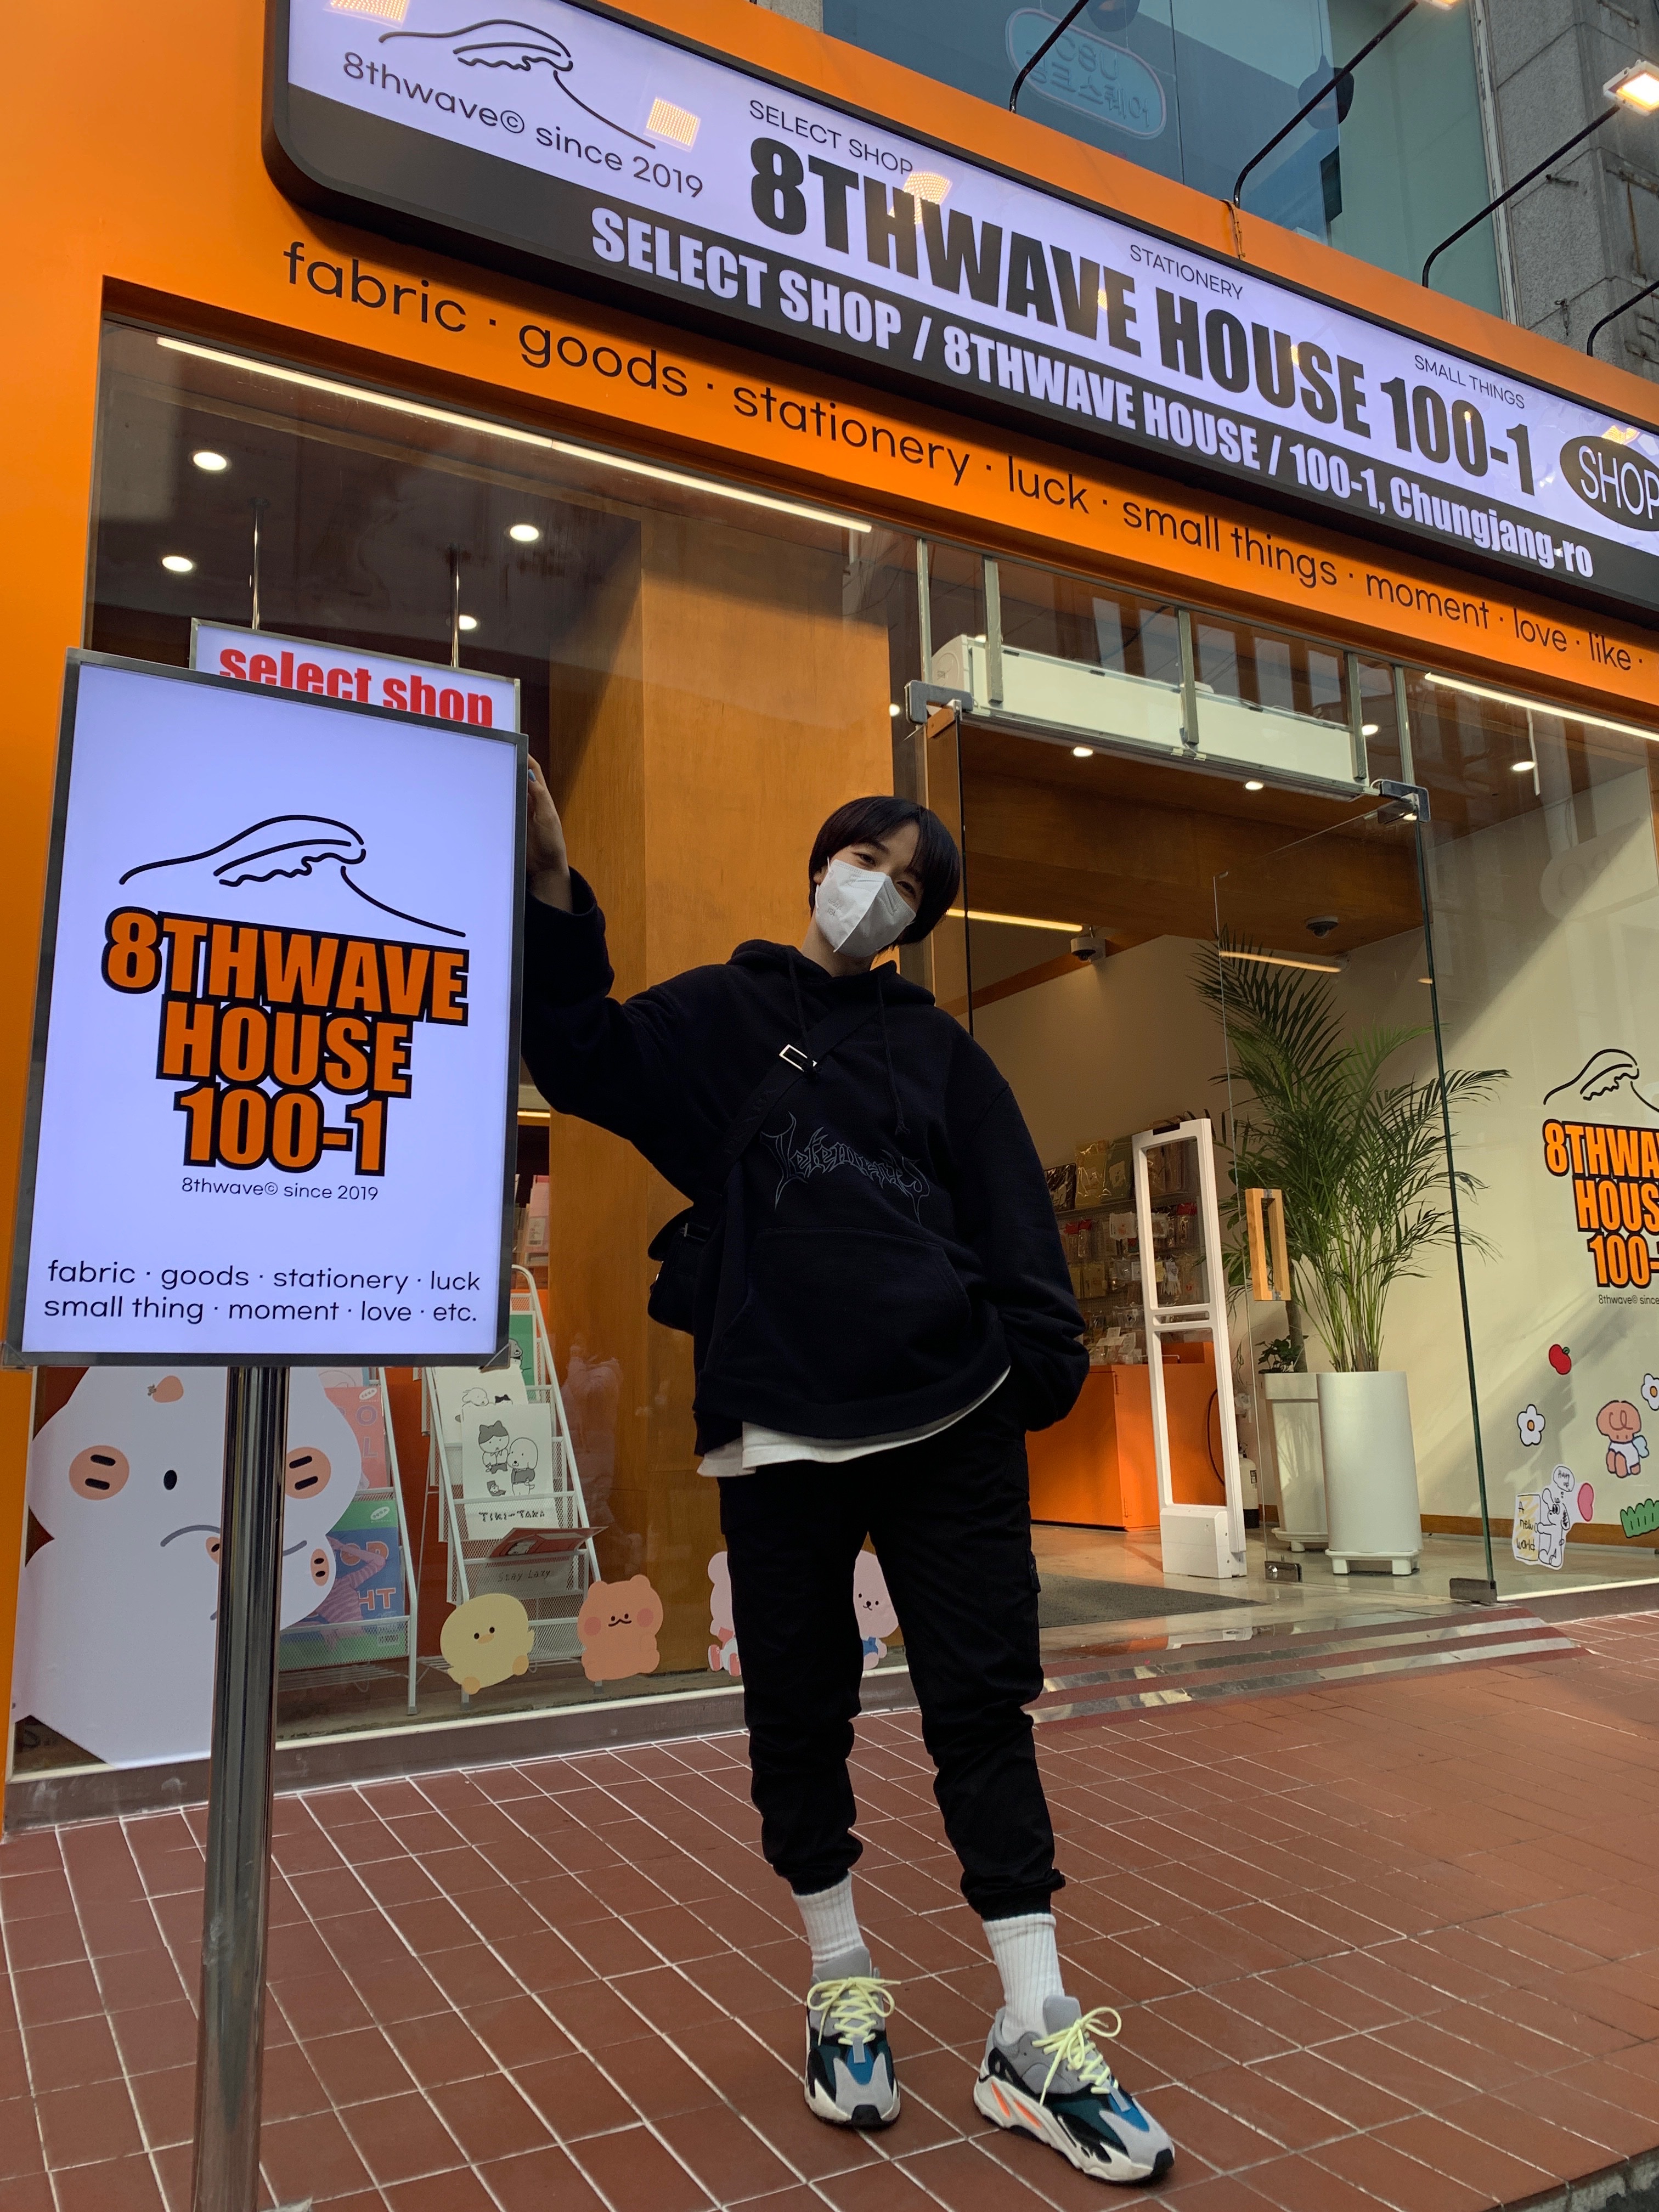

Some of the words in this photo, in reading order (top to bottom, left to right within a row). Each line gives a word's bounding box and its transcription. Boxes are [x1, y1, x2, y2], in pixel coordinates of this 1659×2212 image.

[536, 127, 622, 172] since
[633, 156, 703, 199] 2019
[749, 100, 842, 149] SELECT
[849, 138, 913, 175] SHOP
[1130, 245, 1244, 300] STATIONERY
[751, 137, 1142, 358] 8THWAVE
[1155, 286, 1371, 441] HOUSE
[1380, 377, 1535, 496] 100-1
[591, 207, 768, 309] SELECT
[778, 269, 901, 350] SHOP
[943, 325, 1136, 430] 8THWAVE
[1143, 391, 1261, 471] HOUSE
[1290, 443, 1386, 516] 100-1,
[1390, 476, 1594, 578] Chungjang-ro
[1415, 354, 1466, 386] SMALL
[1469, 375, 1525, 409] THINGS
[283, 241, 466, 332] fabric
[518, 325, 687, 397] goods
[733, 386, 970, 486] stationery
[1008, 455, 1090, 514] luck
[1123, 500, 1220, 552] small
[1231, 526, 1337, 588] things
[1366, 571, 1489, 629] moment
[1513, 608, 1567, 652] love
[1589, 631, 1631, 670] like
[1578, 445, 1659, 520] SHOP
[219, 648, 372, 704] select
[382, 674, 493, 729] shop
[101, 906, 470, 1026] 8THWAVE
[155, 997, 414, 1099] HOUSE
[173, 1083, 388, 1177] 100-1
[1542, 1119, 1659, 1179] 8THWA
[284, 1183, 332, 1198] since
[337, 1185, 379, 1200] 2019
[48, 1260, 136, 1284] fabric
[161, 1265, 250, 1288] goods
[273, 1268, 409, 1294] stationery
[430, 1271, 481, 1291] luck
[1587, 1232, 1659, 1289] 100-
[44, 1296, 122, 1318] small
[132, 1296, 204, 1324] thing
[229, 1301, 340, 1322] moment
[361, 1300, 411, 1323] love
[433, 1303, 477, 1322] etc.
[1640, 1295, 1659, 1305] since
[1518, 1502, 1525, 1514] A
[1520, 1519, 1534, 1531] new
[1516, 1538, 1536, 1552] world
